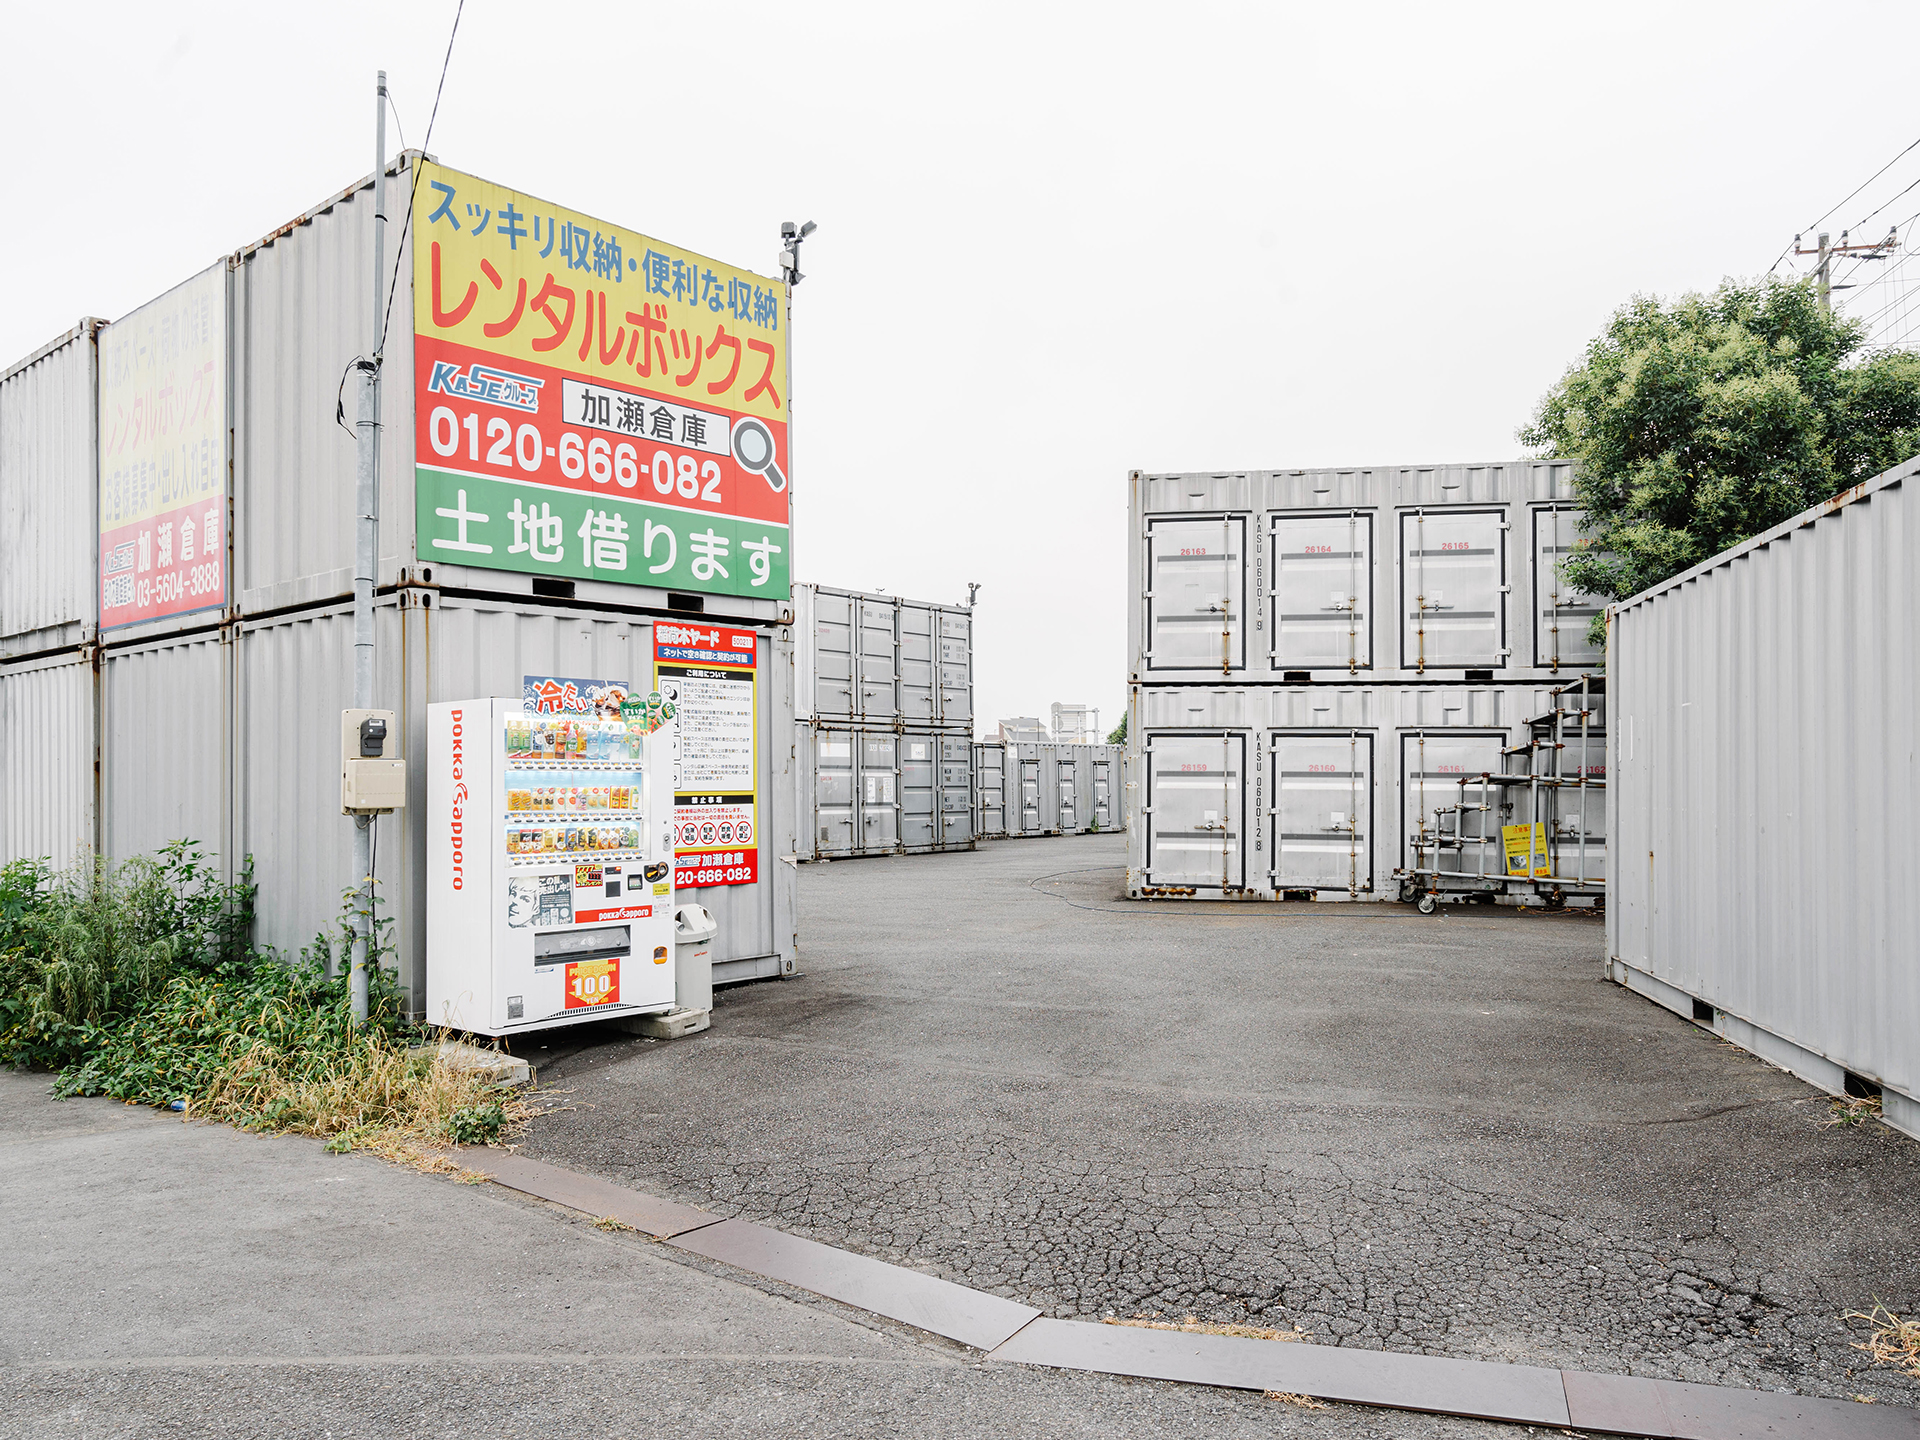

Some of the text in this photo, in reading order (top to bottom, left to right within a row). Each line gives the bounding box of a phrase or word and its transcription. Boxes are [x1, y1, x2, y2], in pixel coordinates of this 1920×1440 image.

[428, 180, 778, 331] スッキリ収納・便利な収納
[431, 241, 780, 410] レンタルボックス
[105, 360, 219, 458] レンタルボックス
[581, 388, 707, 447] 加瀬倉庫
[429, 406, 722, 503] 0120-666-082
[138, 508, 220, 574] 加瀬倉庫
[432, 489, 781, 586] 土地借ります
[1442, 542, 1470, 550] 26165
[137, 561, 220, 608] 03-5604-3888
[686, 669, 727, 679] ご利用について
[1181, 764, 1207, 772] 26159
[1308, 764, 1336, 772] 26160
[1438, 765, 1465, 773] 26161
[701, 852, 744, 867] 加瀬倉庫
[572, 975, 610, 997] 100
